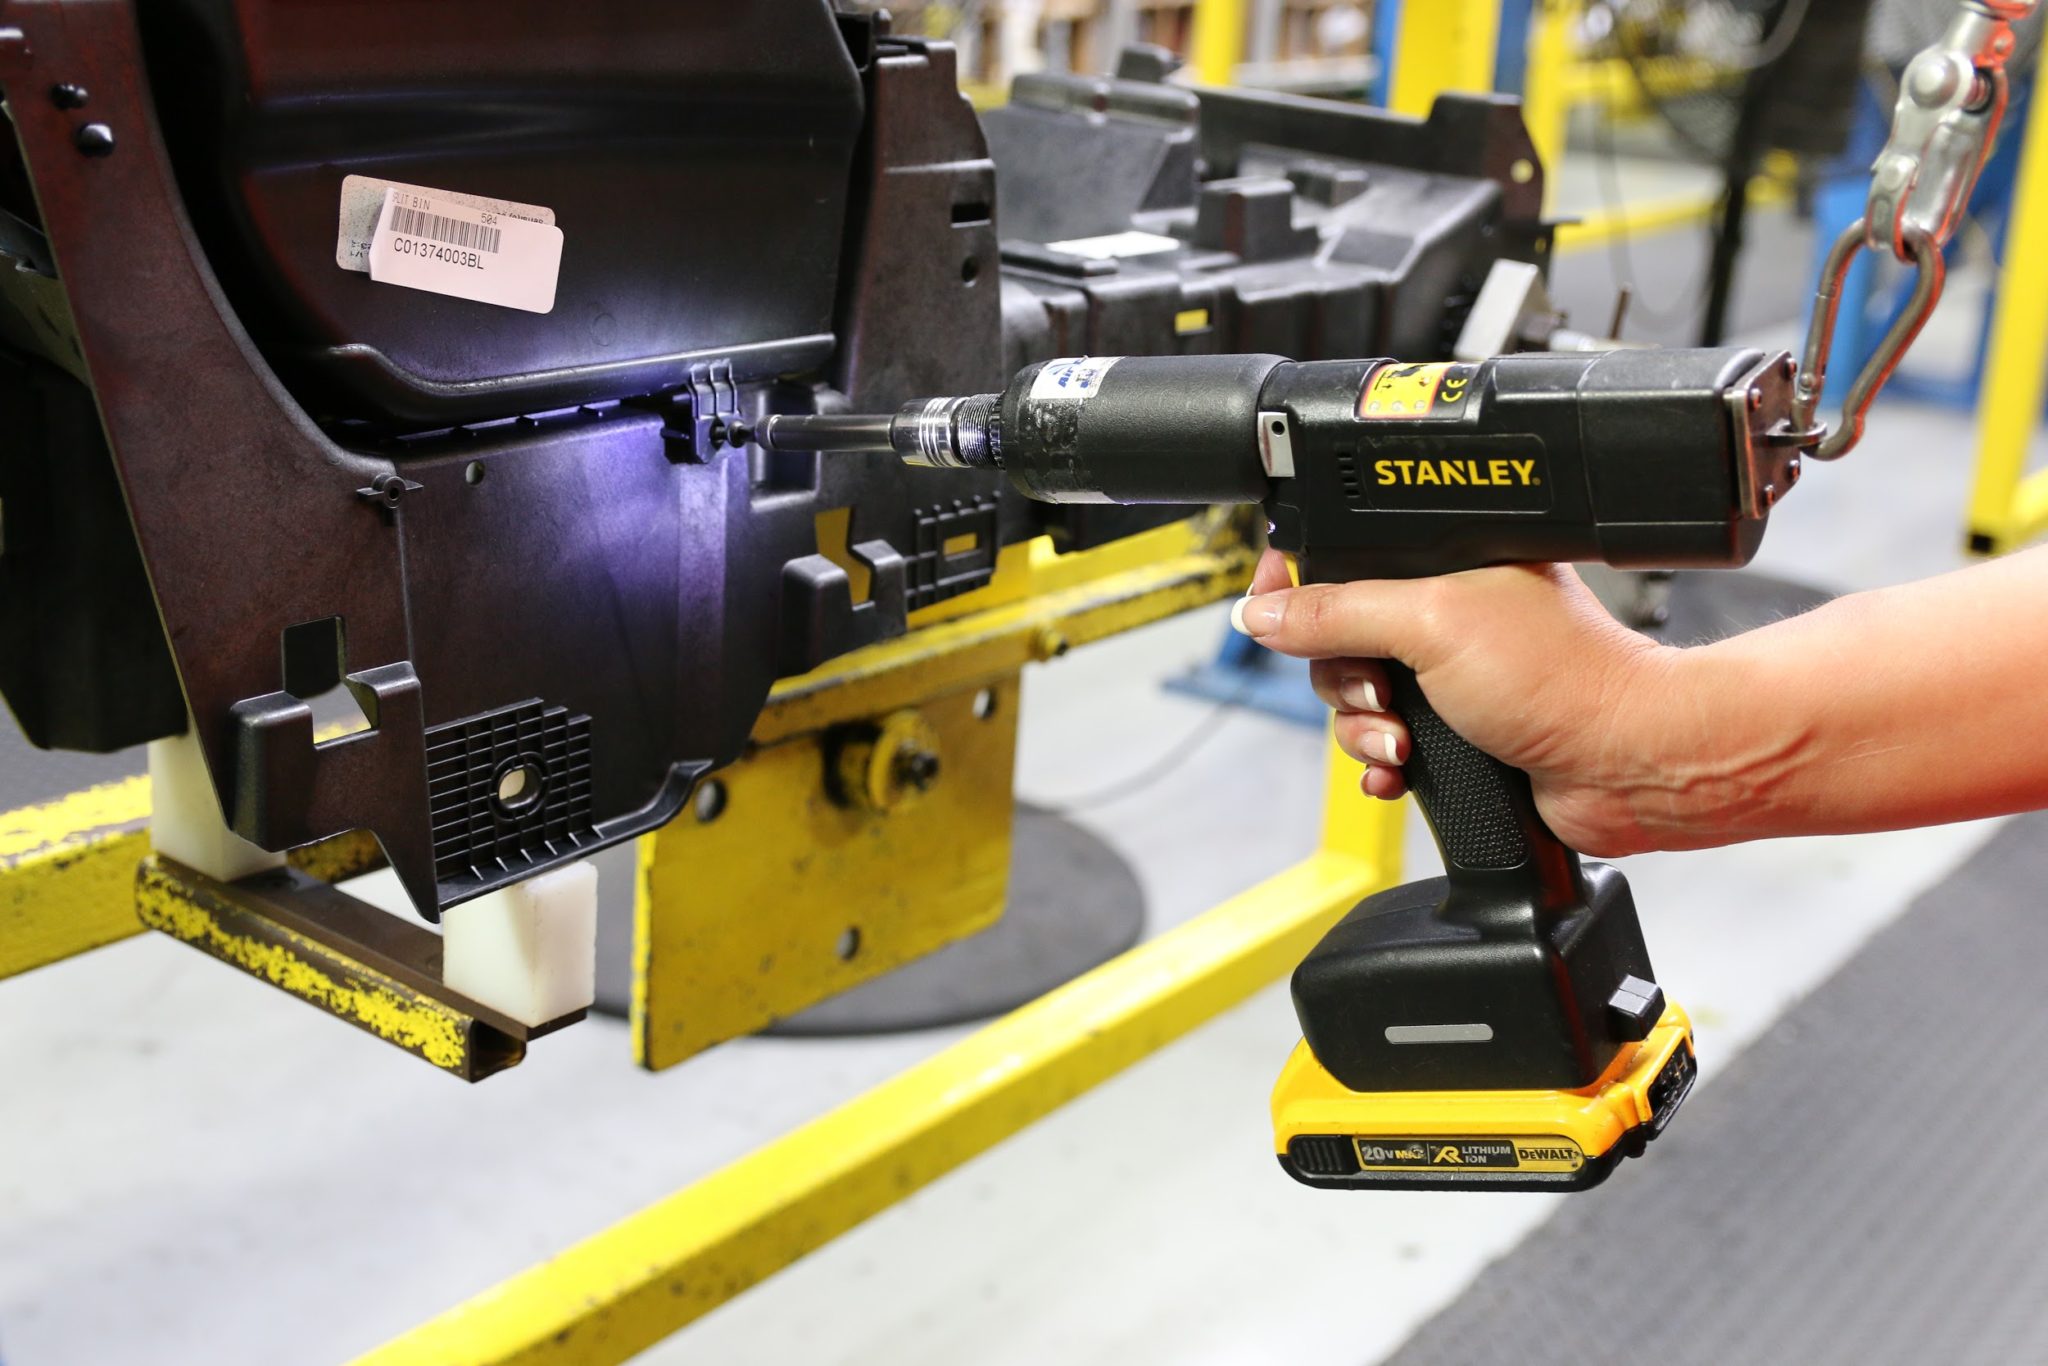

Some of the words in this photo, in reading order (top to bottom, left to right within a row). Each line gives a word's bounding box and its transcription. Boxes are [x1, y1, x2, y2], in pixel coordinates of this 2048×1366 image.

[413, 196, 431, 210] BIN
[481, 212, 498, 226] 504
[394, 237, 484, 270] C01374003BL
[1374, 459, 1536, 486] STANLEY
[1462, 1145, 1511, 1155] LITHIUM
[1465, 1154, 1487, 1164] ION
